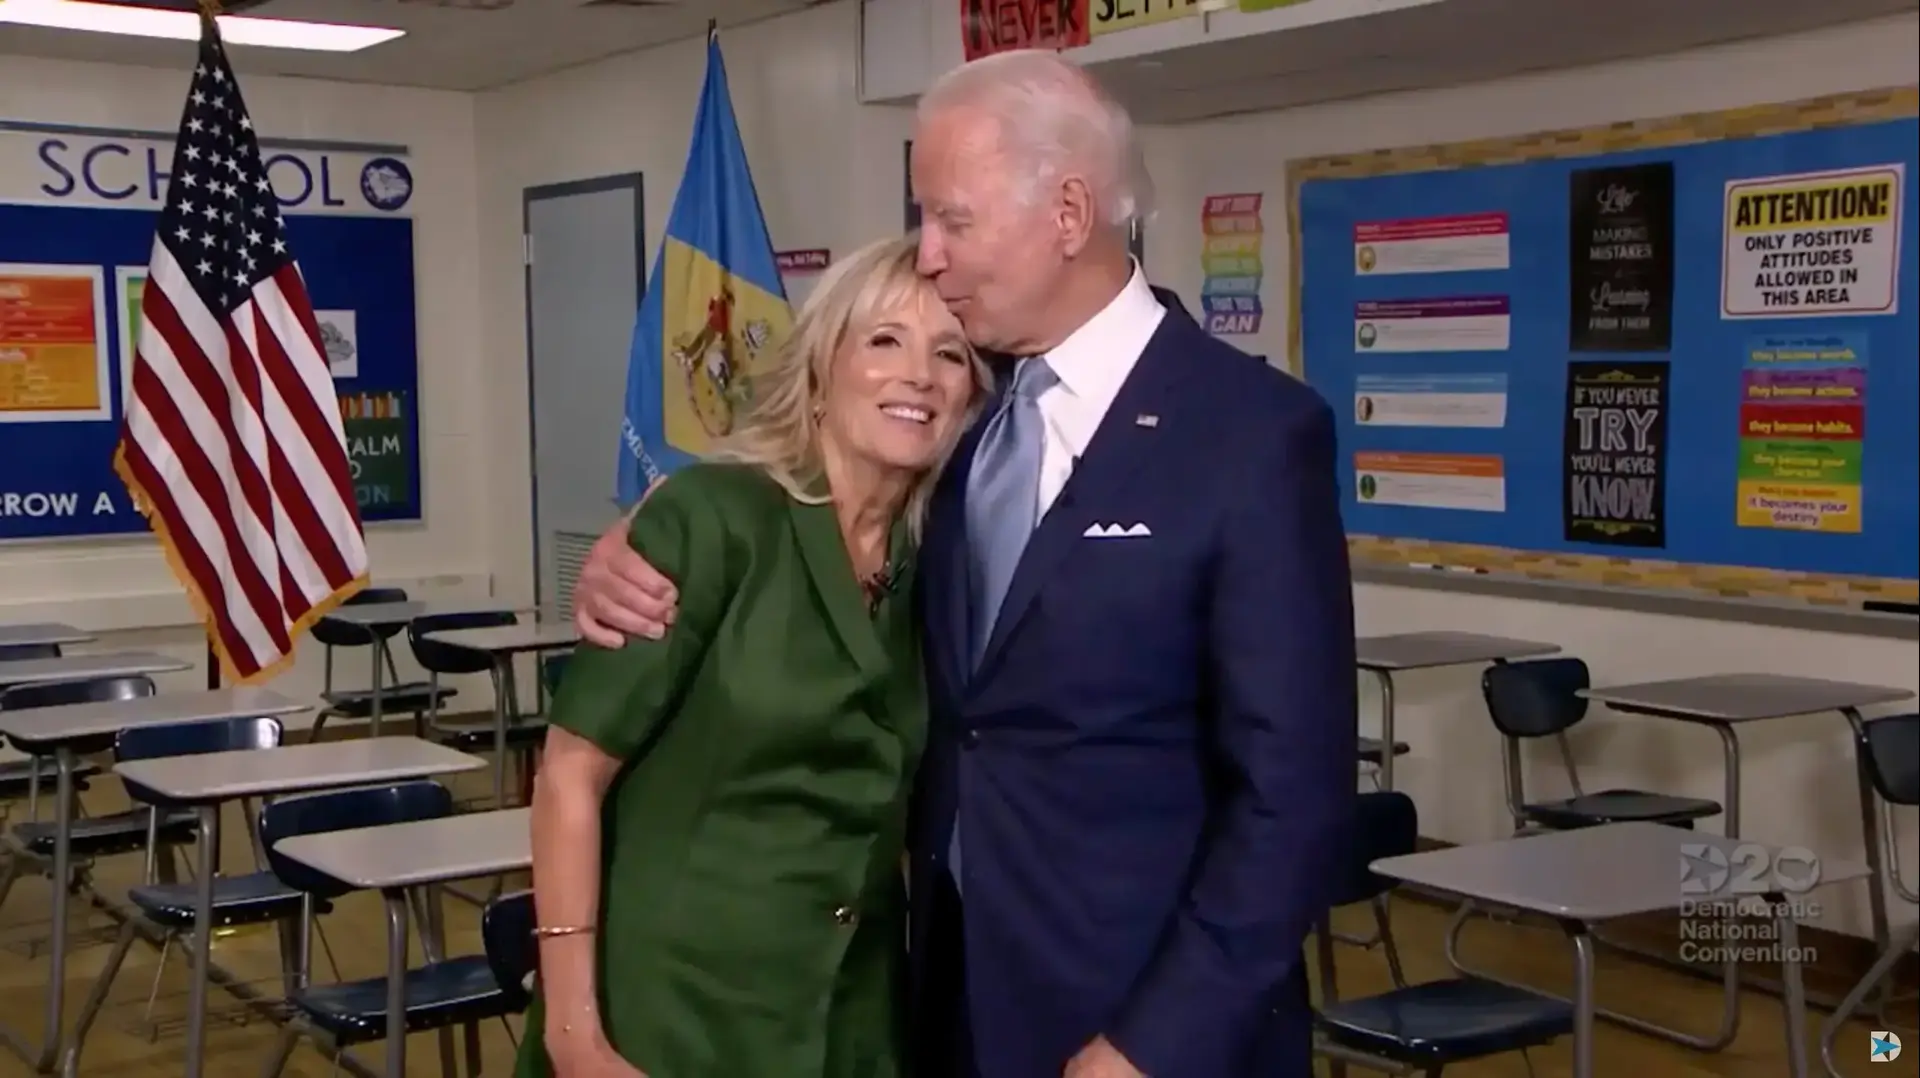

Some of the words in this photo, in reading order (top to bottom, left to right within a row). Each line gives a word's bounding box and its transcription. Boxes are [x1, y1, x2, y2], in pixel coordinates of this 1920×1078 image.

[970, 0, 1080, 48] NEVER
[38, 140, 345, 206] SCHOL
[1735, 183, 1889, 227] ATTENTION!
[1592, 227, 1648, 243] MAKING
[1745, 234, 1786, 251] ONLY
[1793, 228, 1873, 248] POSITIVE
[1589, 244, 1653, 260] MISTAKES
[1760, 249, 1853, 269] ATTITUDES
[1755, 270, 1834, 288] ALLOWED
[1840, 268, 1858, 284] IN
[1762, 290, 1799, 306] THIS
[1804, 288, 1850, 305] AREA
[1211, 314, 1254, 332] CAN
[1574, 386, 1586, 404] IF
[1588, 387, 1615, 405] YOU
[1616, 387, 1660, 405] NEVER
[1573, 407, 1658, 455] TRY,
[1749, 420, 1771, 434] they
[1773, 420, 1814, 433] become
[346, 433, 401, 457] ALM
[1615, 456, 1656, 475] NEVER
[0, 492, 78, 517] ROW
[92, 491, 116, 516] A
[1571, 474, 1656, 521] KNOW.
[1760, 496, 1816, 510] becomes
[1820, 502, 1848, 513] your
